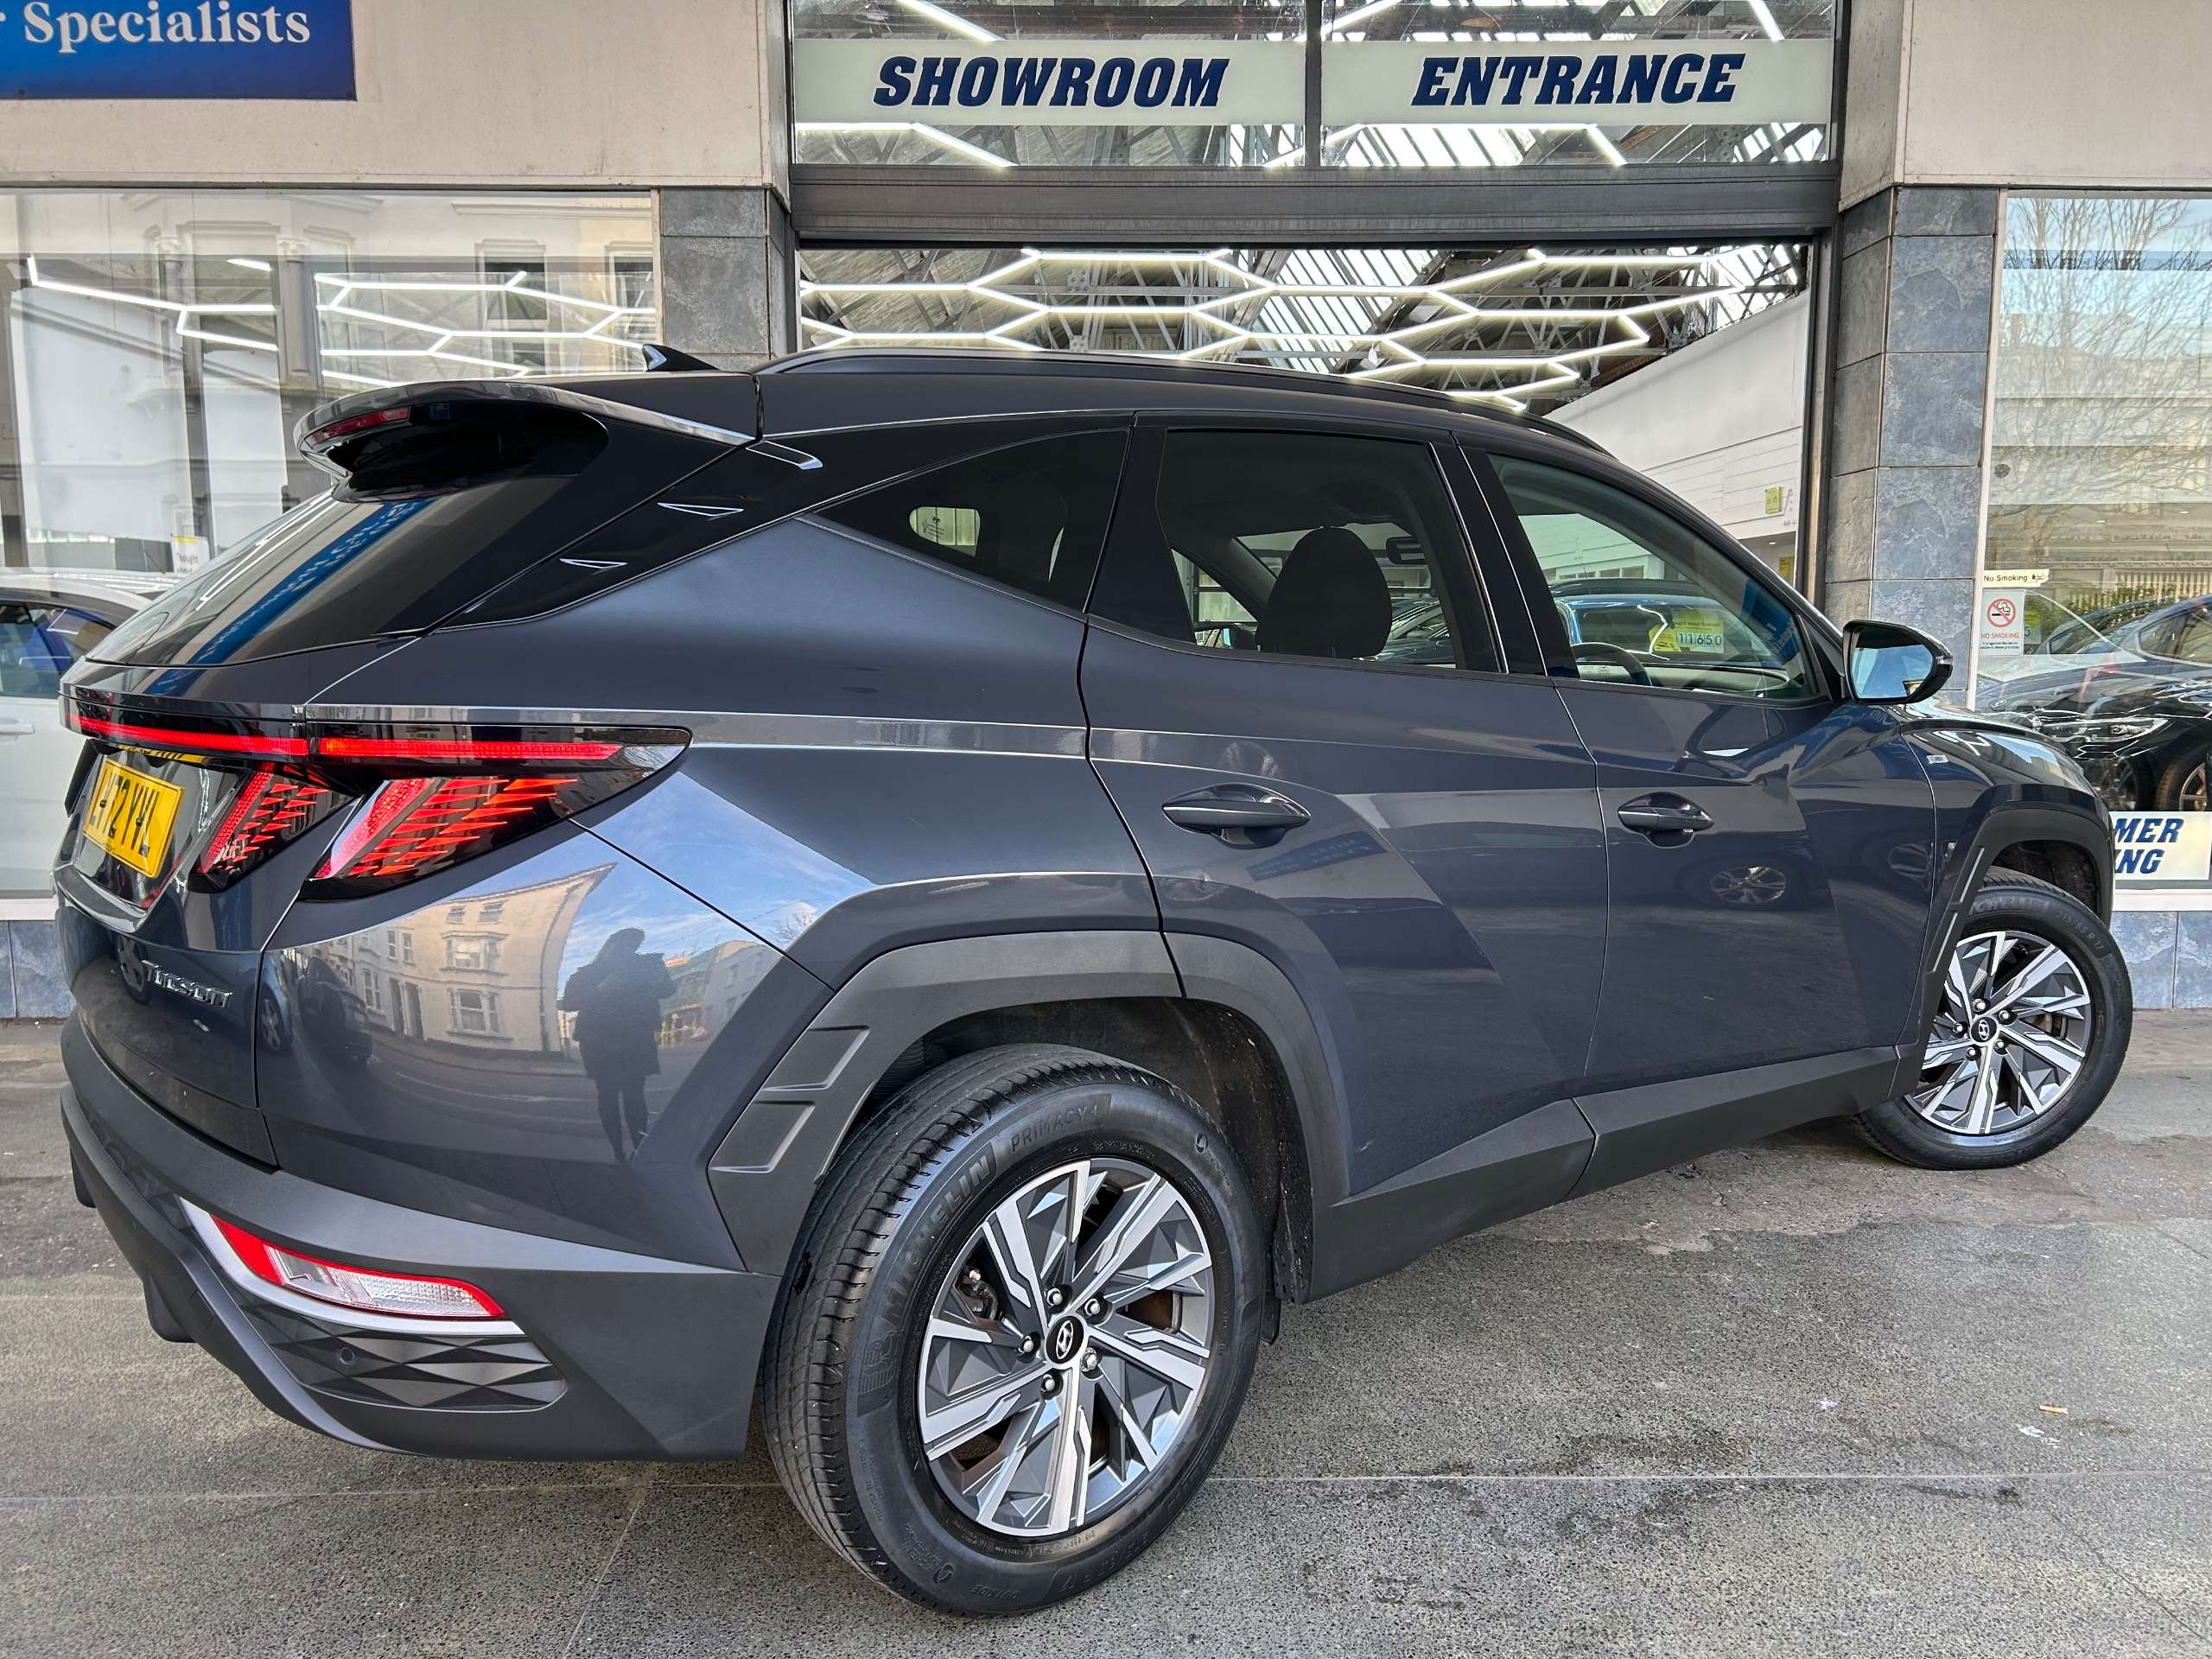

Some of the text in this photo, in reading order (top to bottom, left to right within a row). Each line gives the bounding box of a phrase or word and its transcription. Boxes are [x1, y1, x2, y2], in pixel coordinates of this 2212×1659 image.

[25, 1, 309, 53] Specialists
[874, 54, 1745, 107] SHOWROOM ENTRANCE
[1678, 632, 1722, 646] 11650
